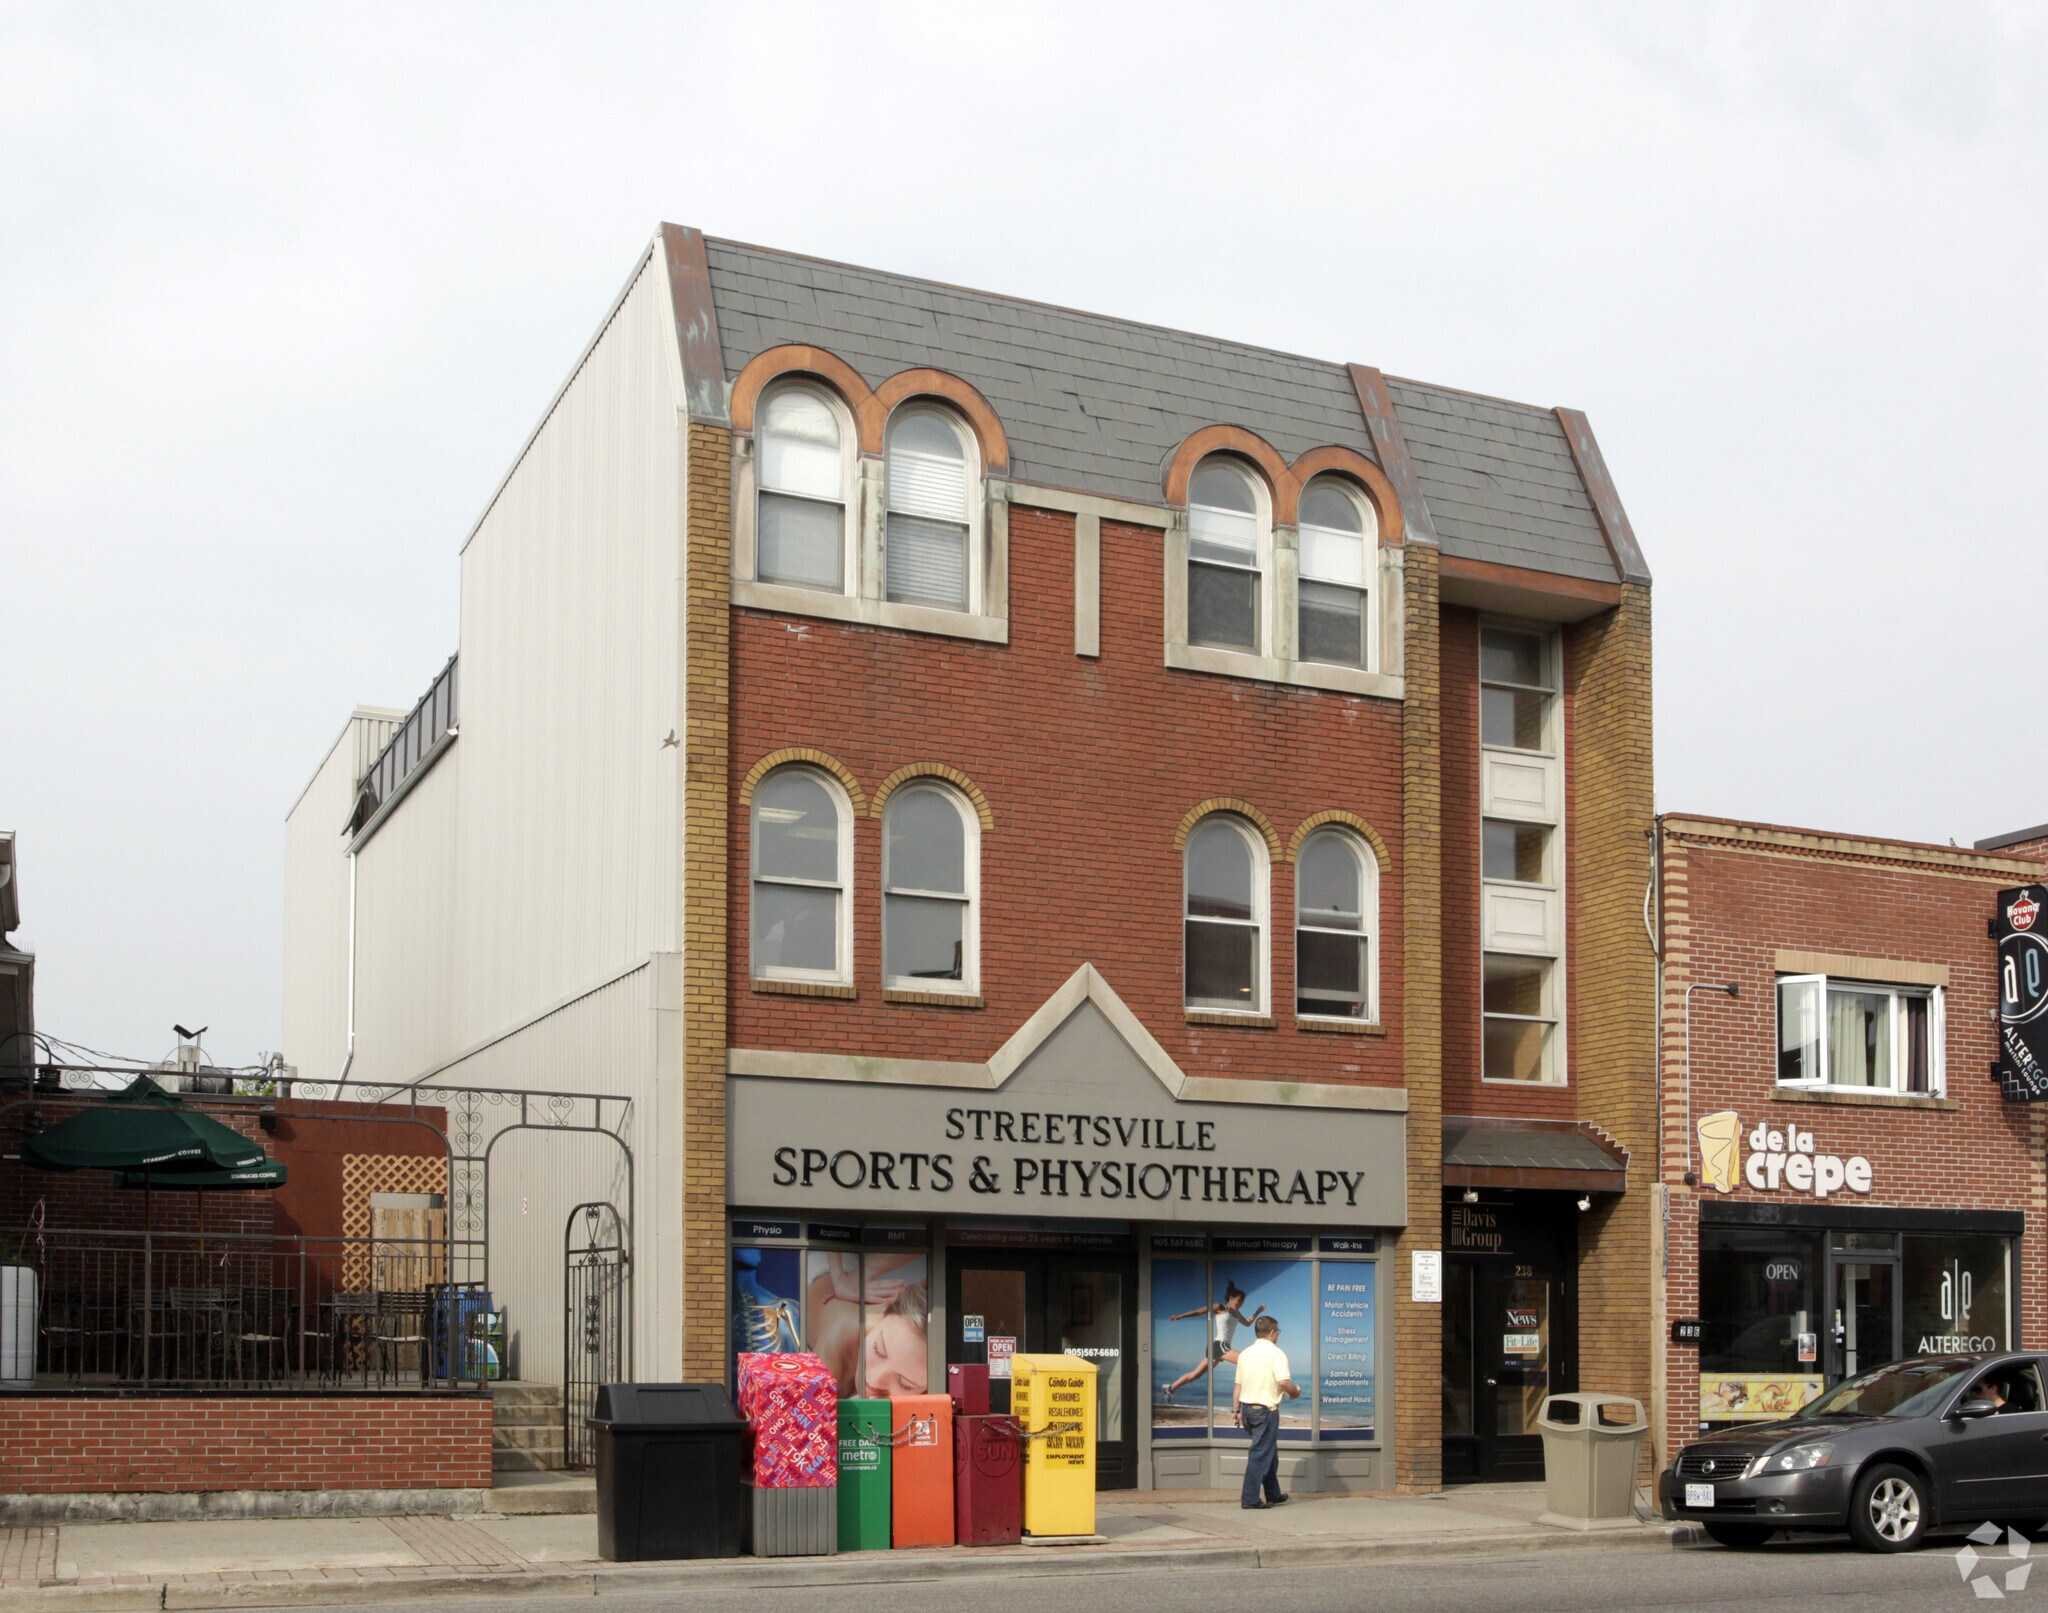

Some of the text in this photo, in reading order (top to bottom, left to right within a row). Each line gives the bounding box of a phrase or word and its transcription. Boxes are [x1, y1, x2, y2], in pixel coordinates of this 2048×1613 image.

[2007, 903, 2040, 918] Havana
[2014, 914, 2031, 926] Club
[2004, 1041, 2024, 1068] martini
[2021, 1067, 2041, 1095] lounge
[945, 1108, 1216, 1151] STREETSVILLE
[1749, 1121, 1815, 1153] de la
[773, 1147, 1365, 1206] SPORTS & PHYSIOTHERAPY
[1745, 1152, 1873, 1197] crepe
[1463, 1208, 1497, 1227] Davis
[753, 1225, 782, 1235] Physio
[960, 1231, 1007, 1244] Celebrating
[1153, 1237, 1204, 1248] 905.567.6680
[1462, 1227, 1502, 1252] Group
[1227, 1239, 1298, 1250] Manual Therapy
[1333, 1241, 1363, 1250] Walk-Ins
[1515, 1265, 1533, 1277] 238
[1766, 1263, 1799, 1280] OPEN
[1327, 1284, 1336, 1292] BE
[1337, 1284, 1351, 1292] PAIN
[1324, 1301, 1369, 1309] Motor Vehicle
[1331, 1310, 1363, 1318] Accidents
[1506, 1311, 1537, 1326] News
[965, 1318, 983, 1328] OPEN
[1337, 1327, 1356, 1335] Stress
[1680, 1326, 1700, 1337] 236
[1325, 1336, 1369, 1344] Management
[1521, 1336, 1538, 1347] Life
[992, 1343, 1013, 1352] OPEN
[1064, 1347, 1120, 1358] (905)567-6680
[1048, 1377, 1084, 1388] Condo Guide
[1324, 1379, 1369, 1387] Appointments
[915, 1422, 931, 1435] 24
[842, 1450, 877, 1461] metro
[978, 1445, 1015, 1462] SUN
